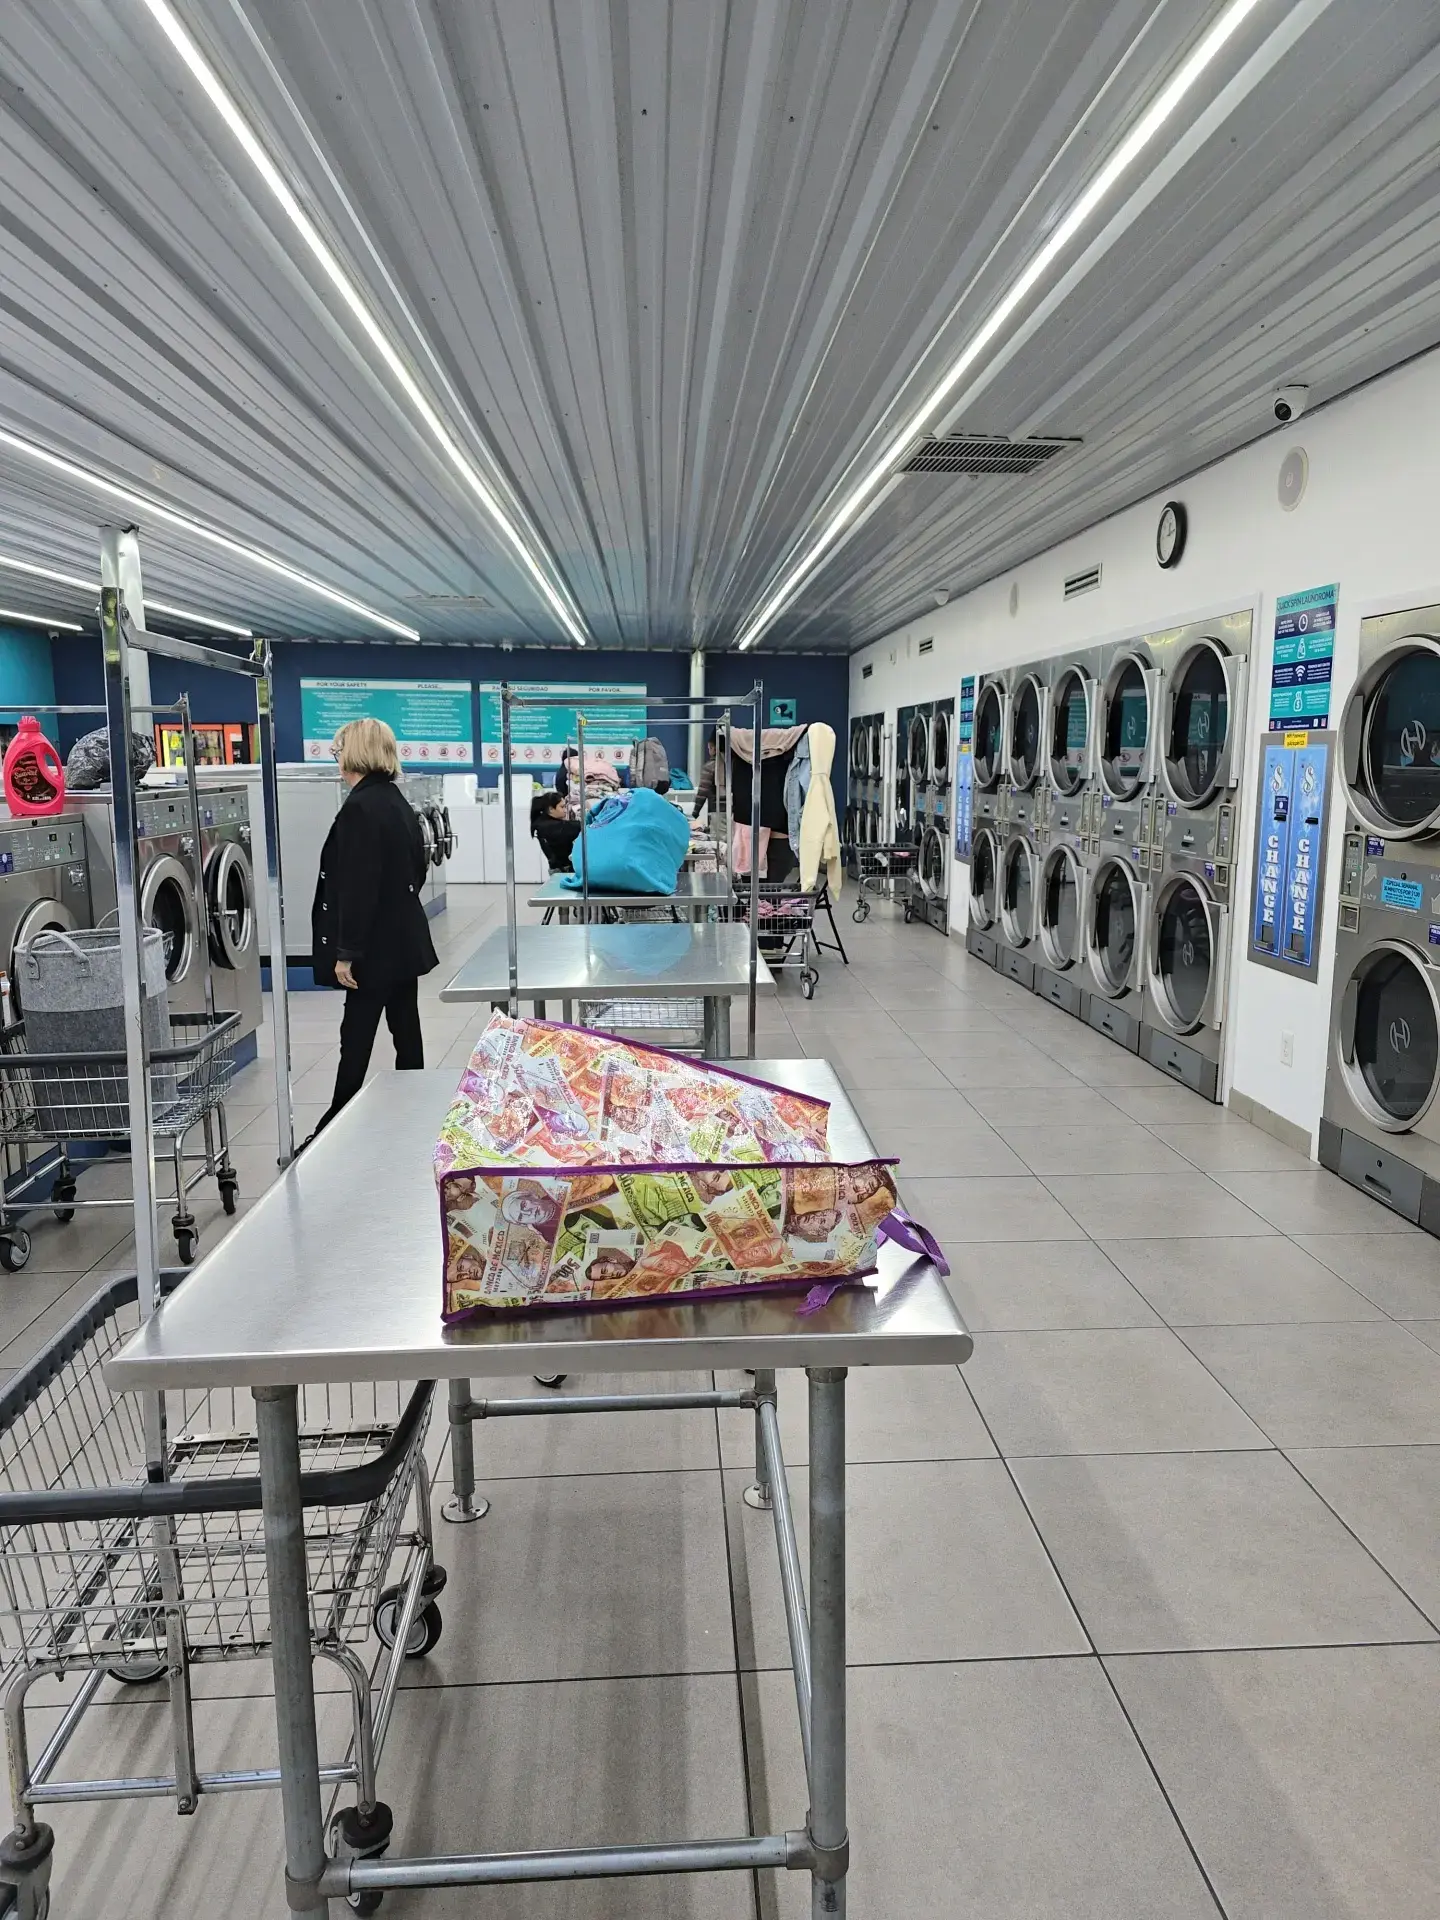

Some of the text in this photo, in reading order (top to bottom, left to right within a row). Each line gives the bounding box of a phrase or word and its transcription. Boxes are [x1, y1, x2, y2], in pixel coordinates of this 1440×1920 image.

[1263, 834, 1279, 924] CHANGE
[1292, 838, 1310, 931] CHANGE
[506, 1054, 514, 1062] DE
[508, 1035, 519, 1054] BANCO
[678, 1175, 695, 1203] MEXICO
[745, 1189, 761, 1210] BANCO
[756, 1209, 765, 1218] DE
[484, 1230, 505, 1295] BANCO DE MEXICO
[555, 1256, 581, 1283] 500
